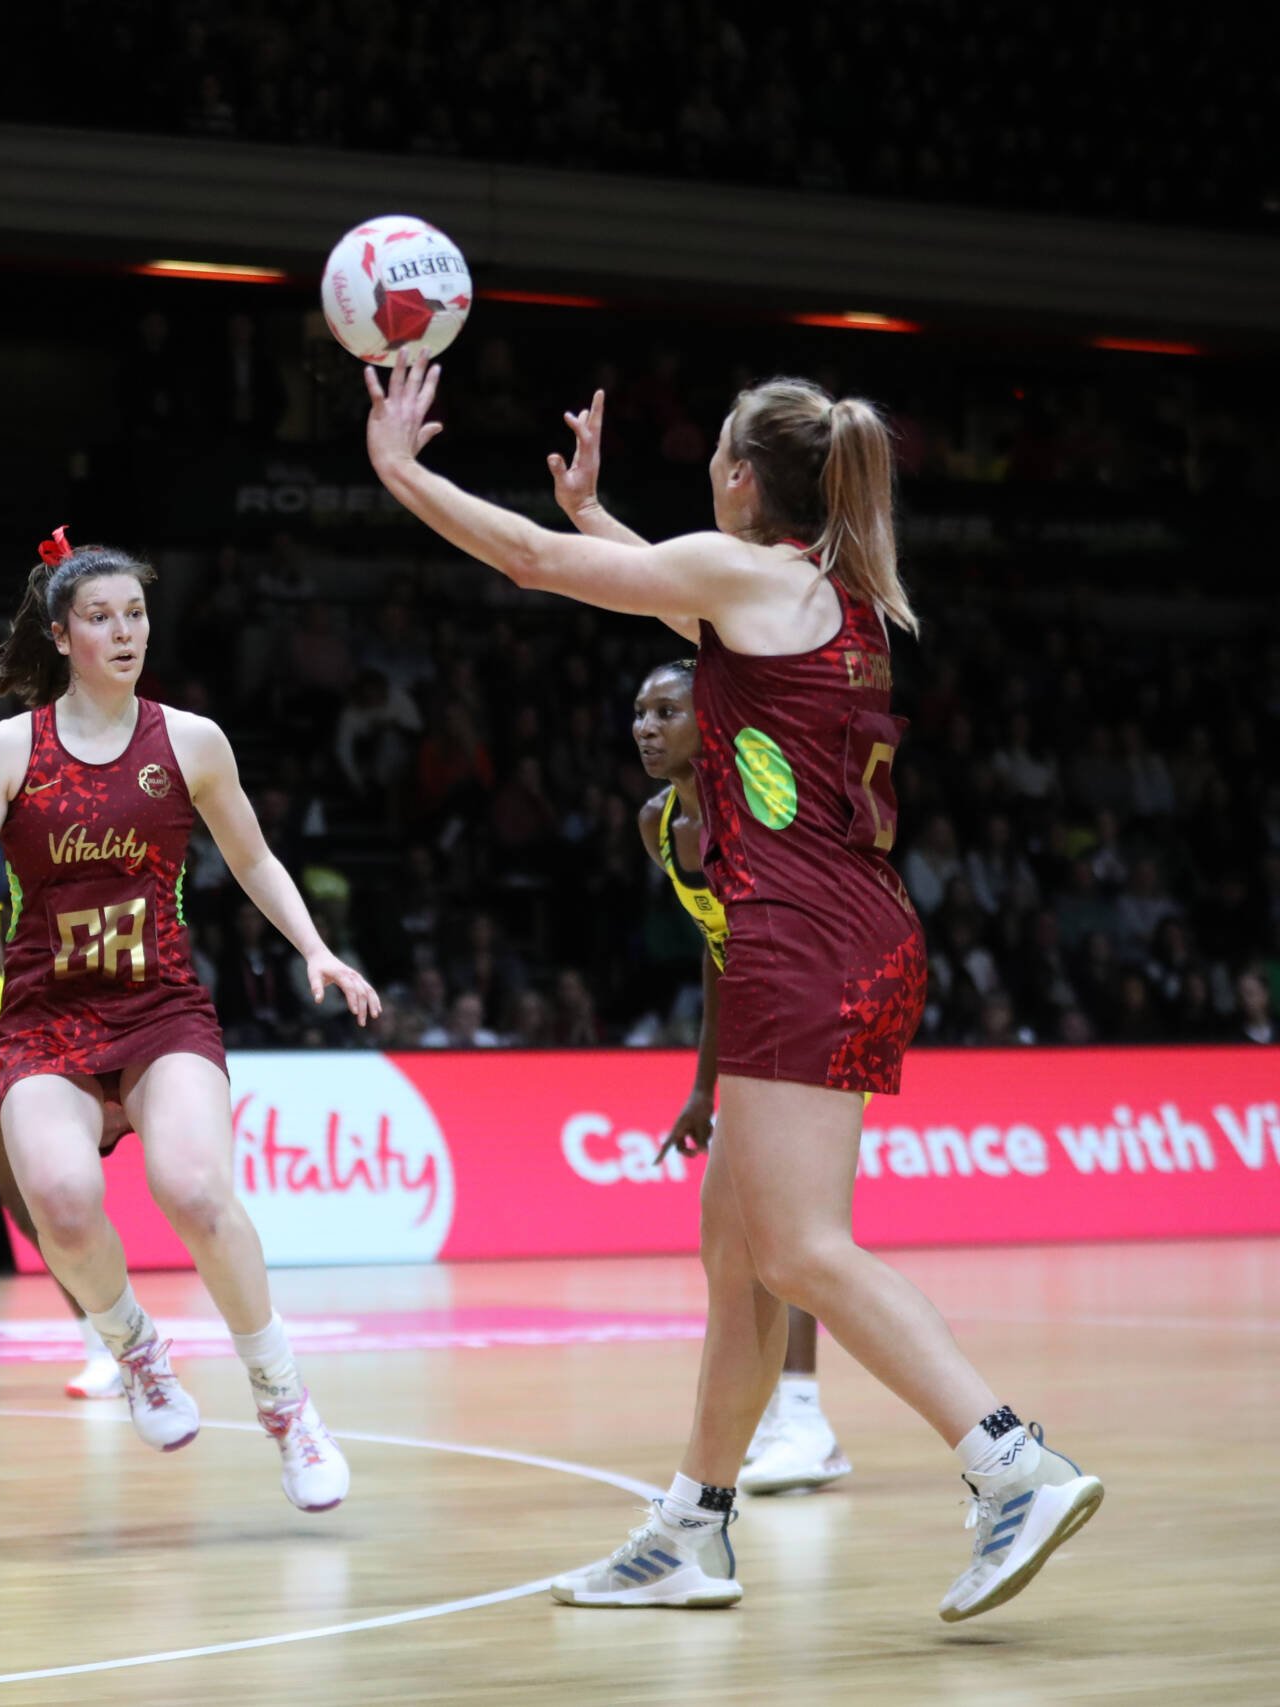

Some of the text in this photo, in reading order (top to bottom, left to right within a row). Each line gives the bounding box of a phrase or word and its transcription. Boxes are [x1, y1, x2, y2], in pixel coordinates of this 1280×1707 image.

[49, 823, 148, 870] Vitality
[54, 898, 146, 982] GA
[1056, 1103, 1215, 1174] with
